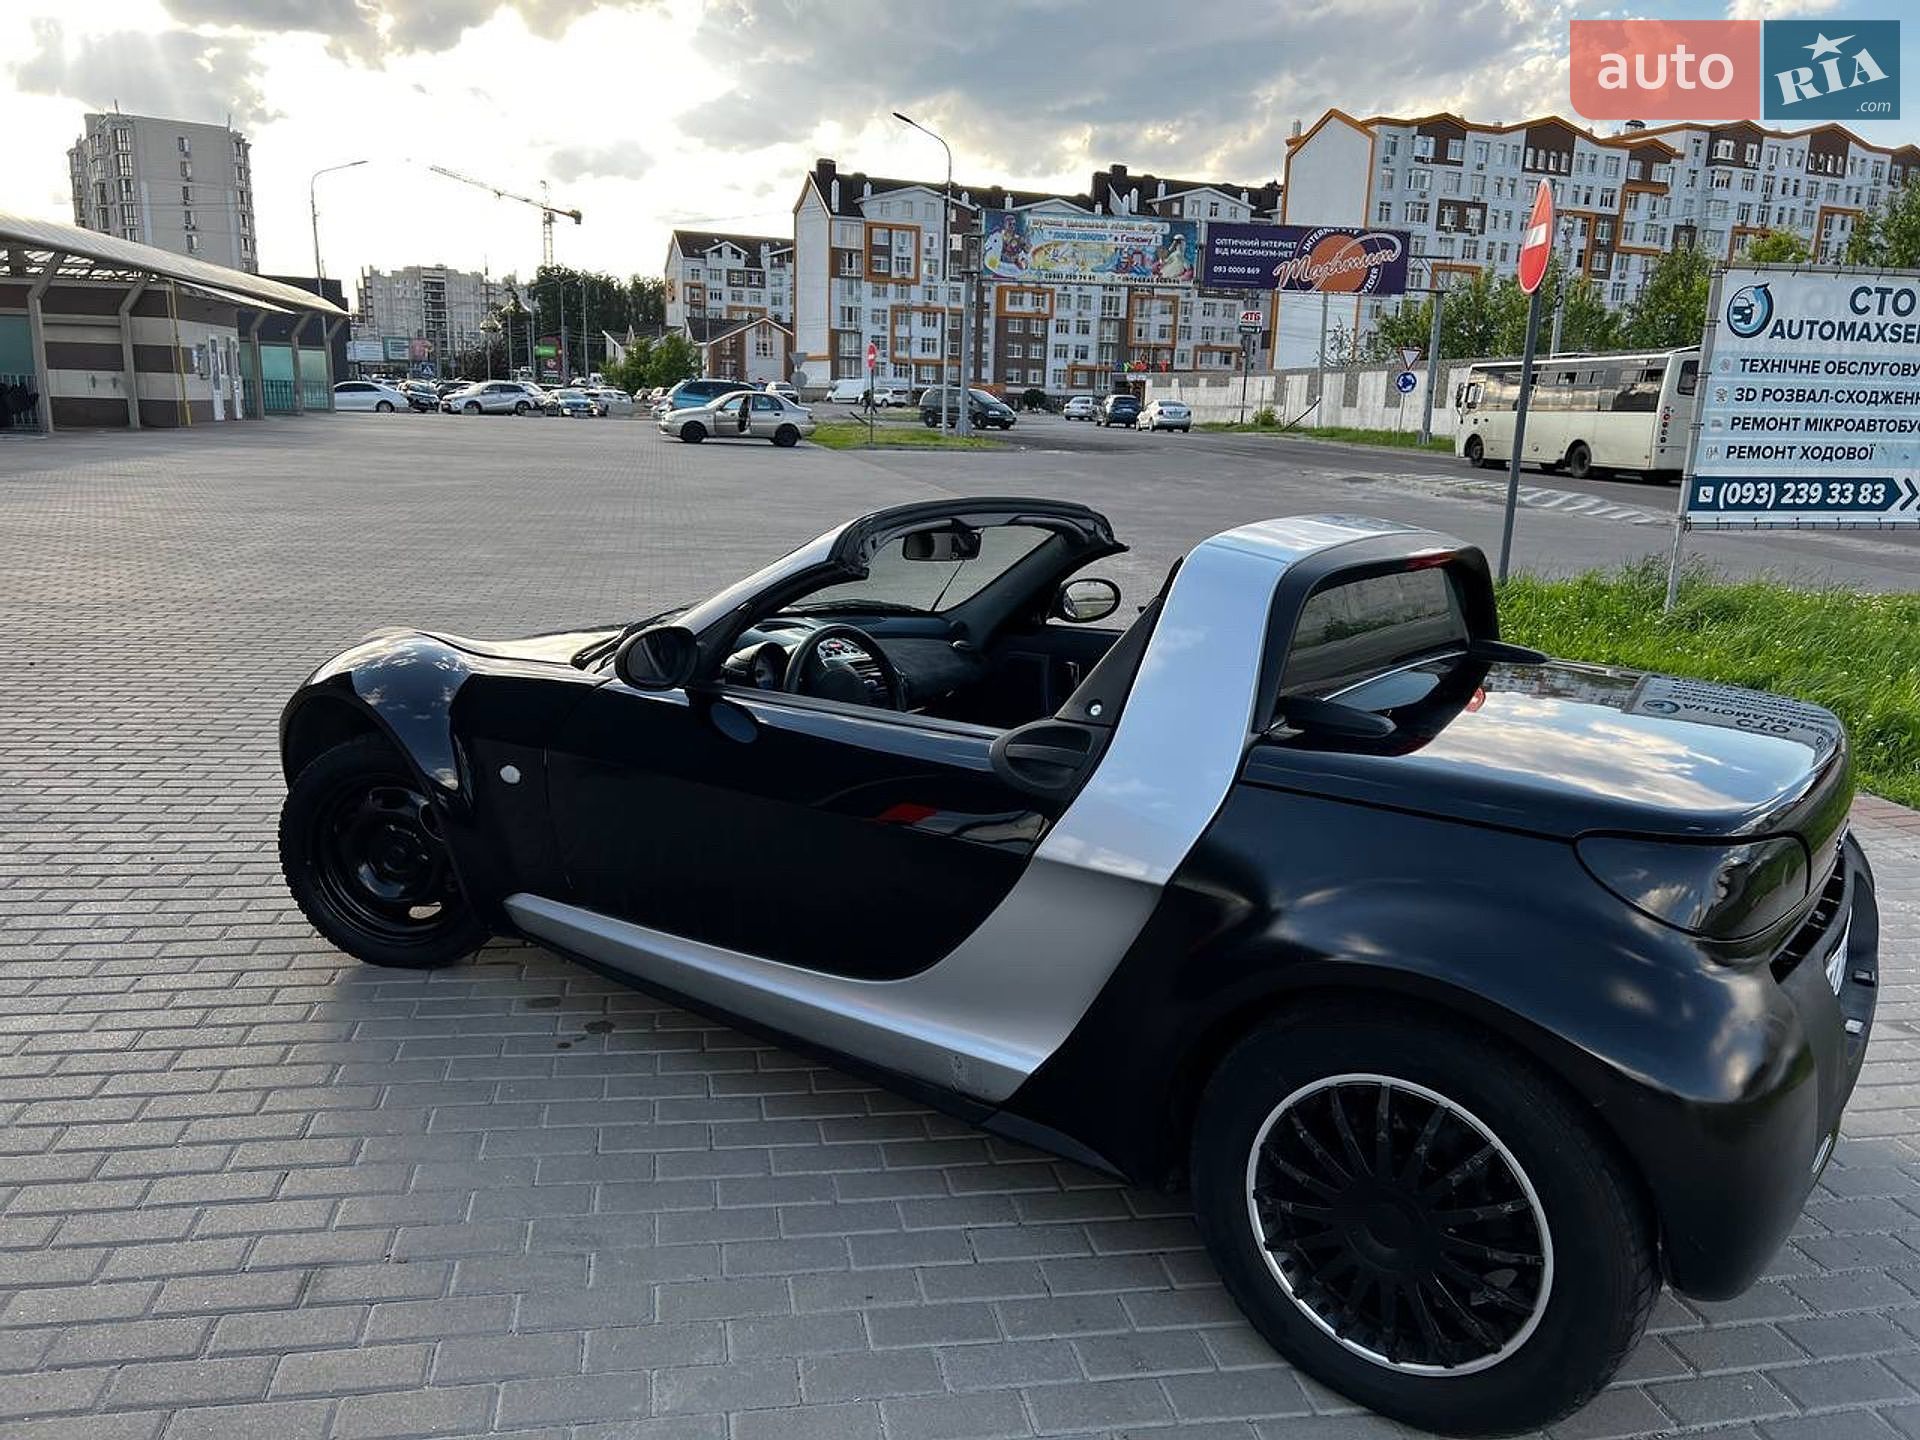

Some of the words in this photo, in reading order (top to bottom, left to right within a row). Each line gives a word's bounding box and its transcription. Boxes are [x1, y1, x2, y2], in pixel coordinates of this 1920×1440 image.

[1215, 238, 1259, 247] ОПТИЧНИЙ
[1261, 241, 1297, 249] ІНТЕРНЕТ
[1215, 247, 1229, 256] ВІД
[1850, 286, 1917, 317] СТО
[1769, 319, 1920, 344] AUTOMAXSE
[1740, 358, 1821, 375] ТЕХНІЧНЕ
[1824, 361, 1920, 377] ОБСЛУГОВУ
[1734, 387, 1757, 402] 3D
[1730, 416, 1800, 431] РЕМОНТ
[1804, 417, 1920, 433] МІКРОАВТОБУ
[1726, 445, 1797, 460] РЕМОНТ
[1799, 443, 1877, 461] ХОДОВОЇ
[1718, 483, 1776, 509] (093)
[1780, 483, 1824, 504] 239
[1827, 483, 1855, 504] 33
[1858, 483, 1886, 504] 83
